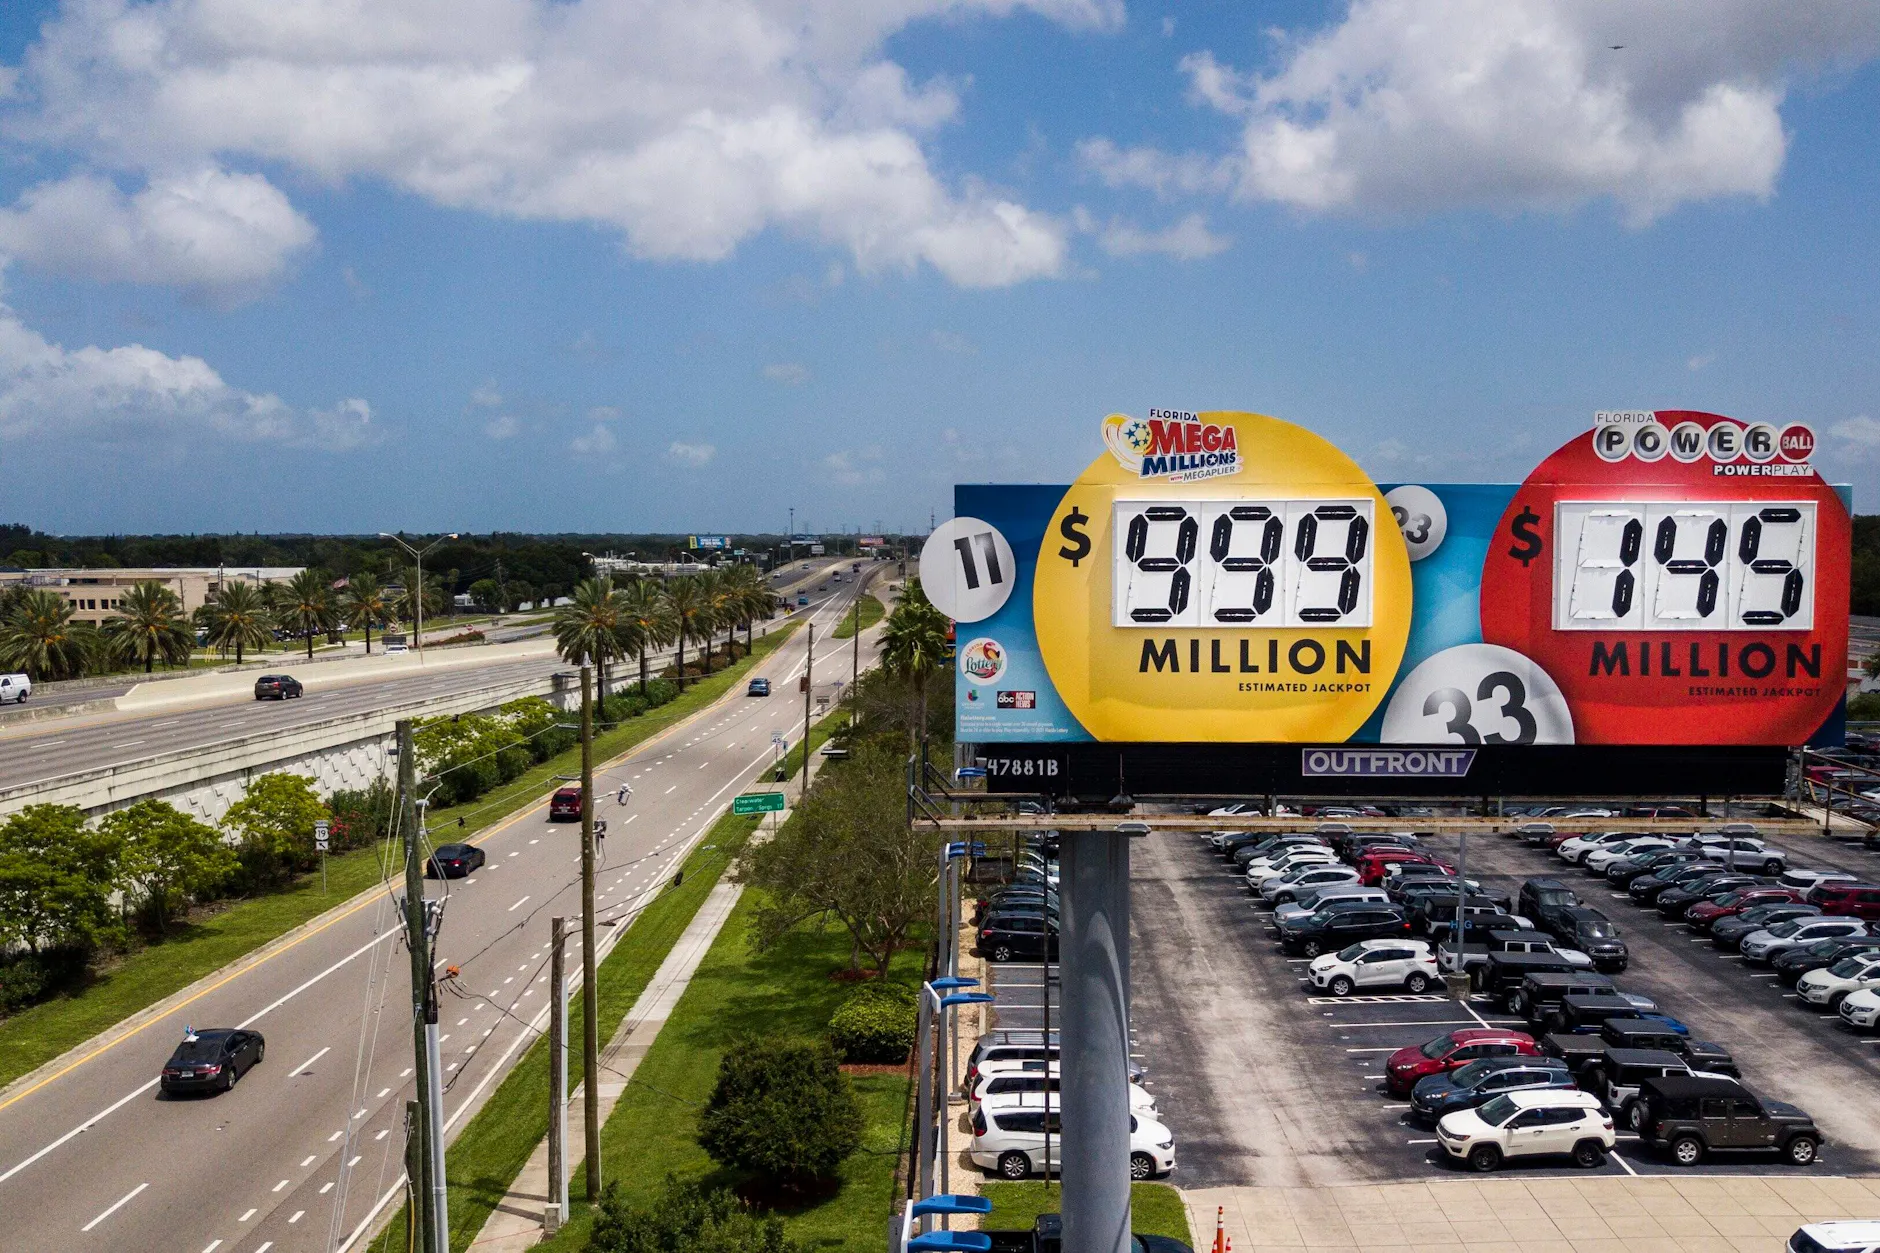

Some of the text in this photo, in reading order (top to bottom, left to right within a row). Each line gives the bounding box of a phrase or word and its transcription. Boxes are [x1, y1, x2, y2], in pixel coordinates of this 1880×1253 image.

[1150, 409, 1198, 421] FLORIDA
[1597, 413, 1654, 423] FLORIDA
[1143, 420, 1236, 457] MEGA
[1141, 452, 1236, 476] MILLIONS
[1183, 466, 1236, 481] MEGAPLIER
[953, 531, 1003, 590] 11
[1058, 505, 1369, 623] $ 999
[1507, 505, 1804, 625] $ 145
[965, 642, 983, 657] FLORIDA
[1138, 638, 1371, 675] MILLION
[965, 657, 1003, 675] Lottery
[1588, 641, 1821, 679] MILLION
[1239, 683, 1371, 693] ESTIMATED JACKPOT
[1688, 686, 1821, 697] ESTIMATED JACKPOT
[998, 692, 1034, 703] abc ACTION
[1015, 700, 1031, 708] NEWS
[1423, 671, 1537, 745] 33
[987, 758, 1059, 776] 47881B
[1308, 752, 1467, 773] OUTFRONT
